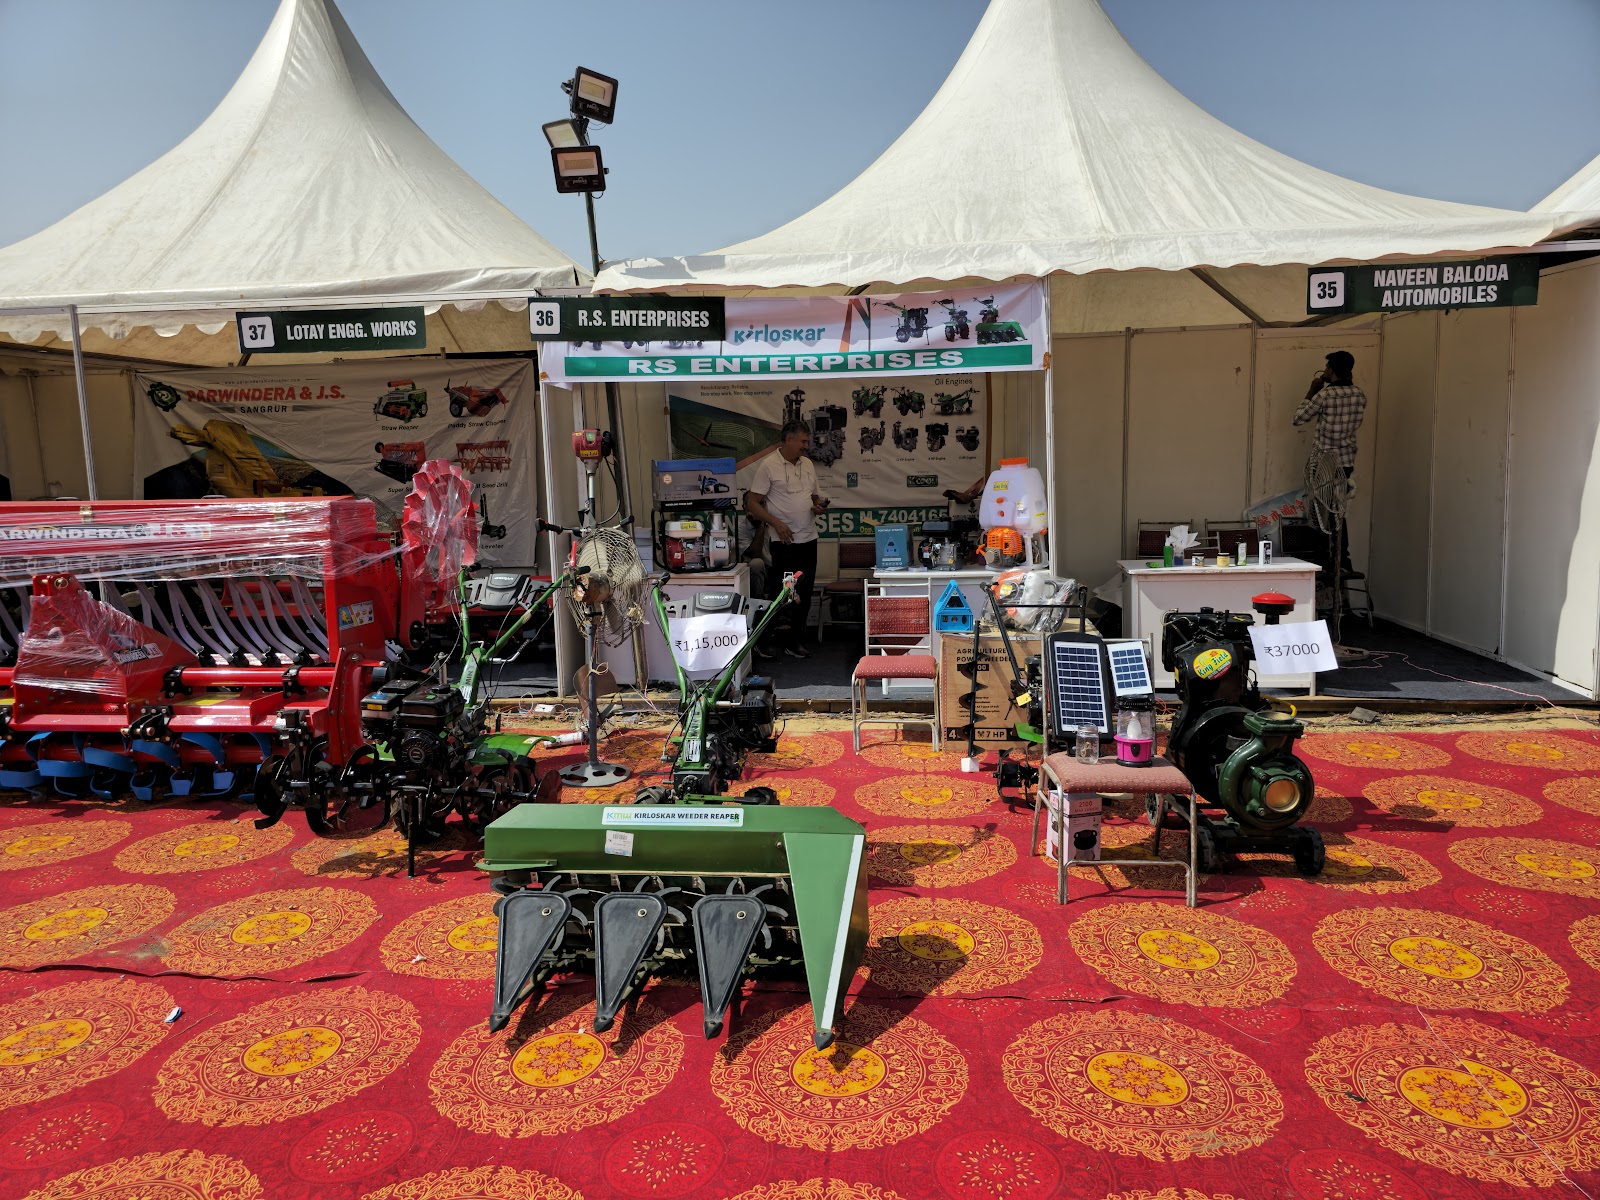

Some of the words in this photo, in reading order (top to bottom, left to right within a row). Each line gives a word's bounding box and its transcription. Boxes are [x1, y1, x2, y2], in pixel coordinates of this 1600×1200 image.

[1373, 267, 1438, 287] NAVEEN
[1442, 263, 1509, 284] BALODA
[1317, 280, 1337, 300] 35
[1381, 284, 1498, 308] AUTOMOBILES
[536, 309, 554, 327] 36
[578, 309, 607, 327] R.S.
[611, 309, 710, 328] ENTERPRISES
[248, 324, 267, 341] 37
[286, 323, 325, 341] LOTAY
[328, 322, 368, 339] ENGG.
[369, 320, 417, 338] WORKS
[734, 323, 826, 343] kirloskar
[628, 358, 677, 374] RS
[690, 350, 964, 374] ENTERPRISES
[934, 378, 944, 386] Oil
[945, 378, 973, 387] Engines
[185, 385, 297, 403] PARWINDERA
[299, 385, 313, 400] &
[316, 384, 346, 399] J.S.
[240, 405, 288, 414] SANGRUR
[674, 634, 739, 653] ₹1,15,000
[1264, 642, 1320, 658] ₹37000
[1197, 663, 1213, 678] King
[1213, 650, 1229, 665] Field
[634, 812, 676, 820] KIRLOSKAR
[677, 812, 709, 820] WEEDER
[710, 812, 740, 820] REAPER
